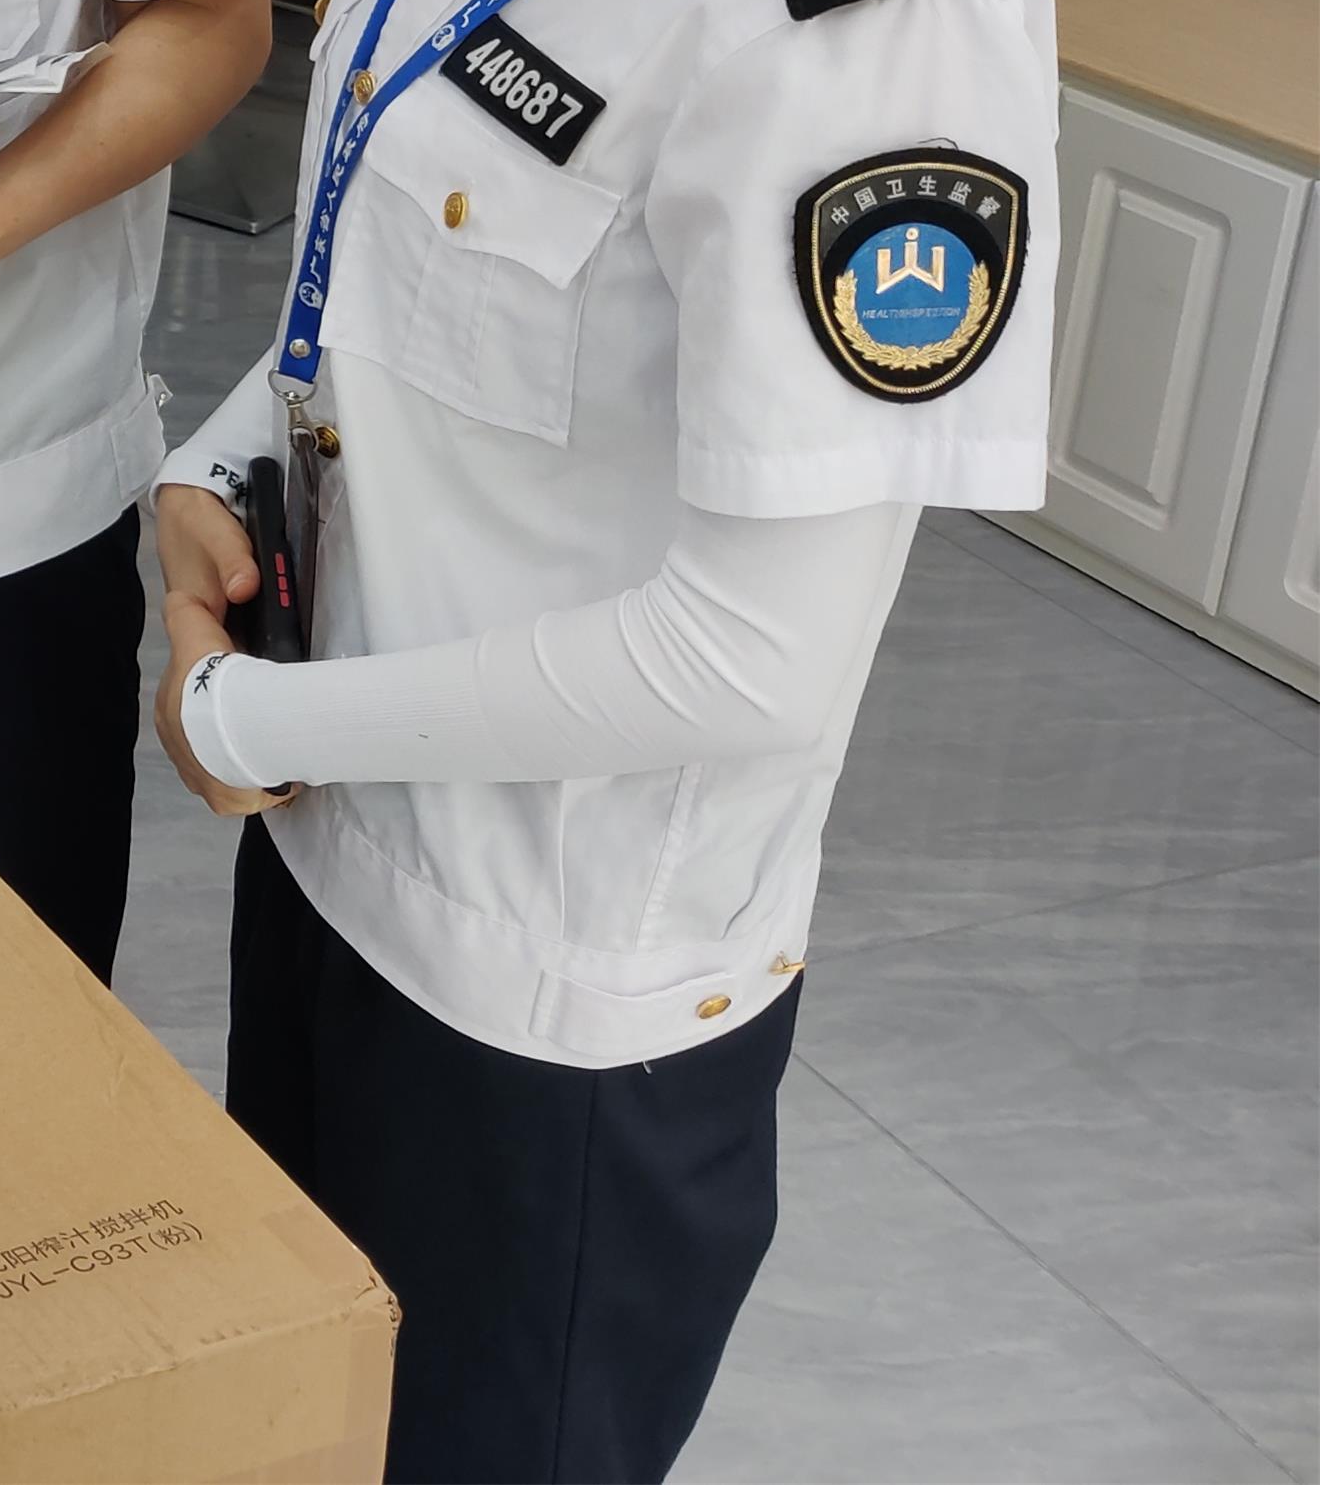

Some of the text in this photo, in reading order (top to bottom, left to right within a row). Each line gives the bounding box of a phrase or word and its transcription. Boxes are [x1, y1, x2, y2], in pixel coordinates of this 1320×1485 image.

[465, 38, 583, 138] 448687
[831, 175, 1001, 225] 中国卫生监督
[0, 1221, 204, 1300] JYL-C93T(粉)
